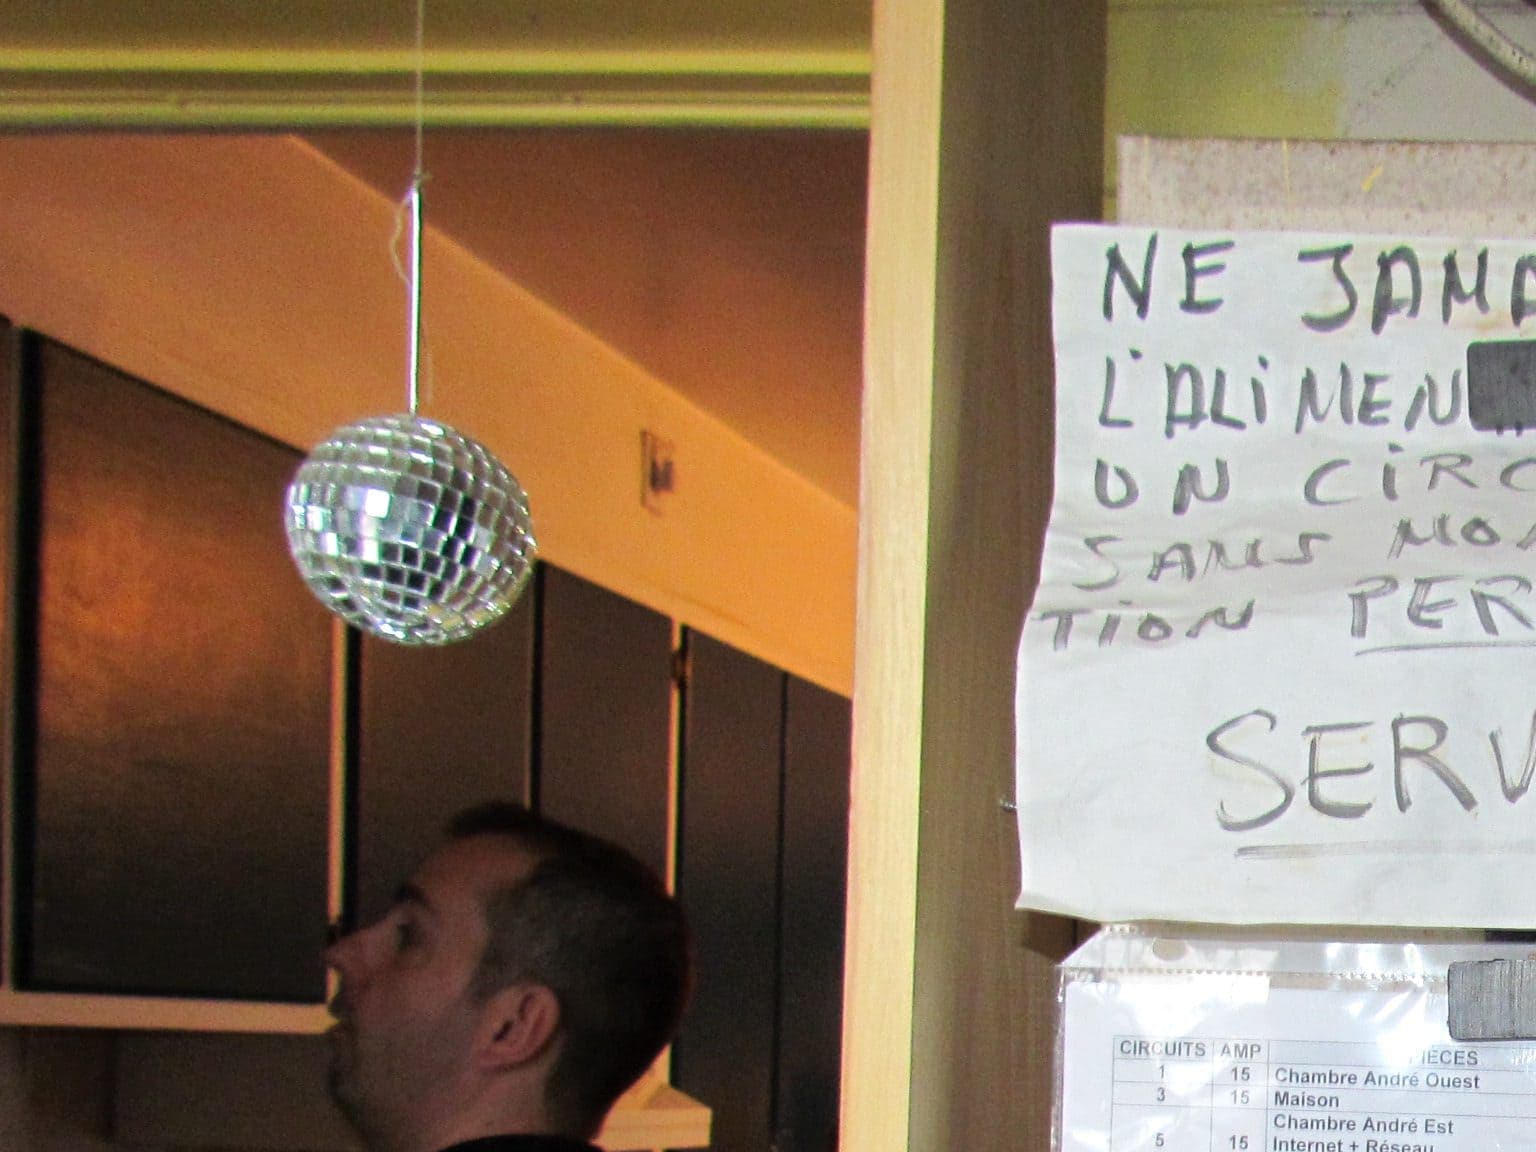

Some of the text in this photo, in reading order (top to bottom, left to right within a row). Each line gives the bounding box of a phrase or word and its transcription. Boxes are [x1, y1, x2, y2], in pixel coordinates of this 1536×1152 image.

[1103, 232, 1235, 321] NE
[1095, 458, 1229, 514] UN
[1073, 532, 1331, 590] SANS
[1120, 1040, 1206, 1057] CIRCUITS
[1220, 1043, 1261, 1060] AMP
[1231, 1066, 1251, 1082] 15
[1274, 1066, 1358, 1086] Chambre
[1364, 1069, 1420, 1088] André
[1425, 1072, 1481, 1090] Ouest
[1156, 1087, 1340, 1109] 3 15 Maison
[1273, 1114, 1454, 1135] Chambre André Est
[1155, 1132, 1165, 1148] 5
[1229, 1135, 1249, 1150] 15
